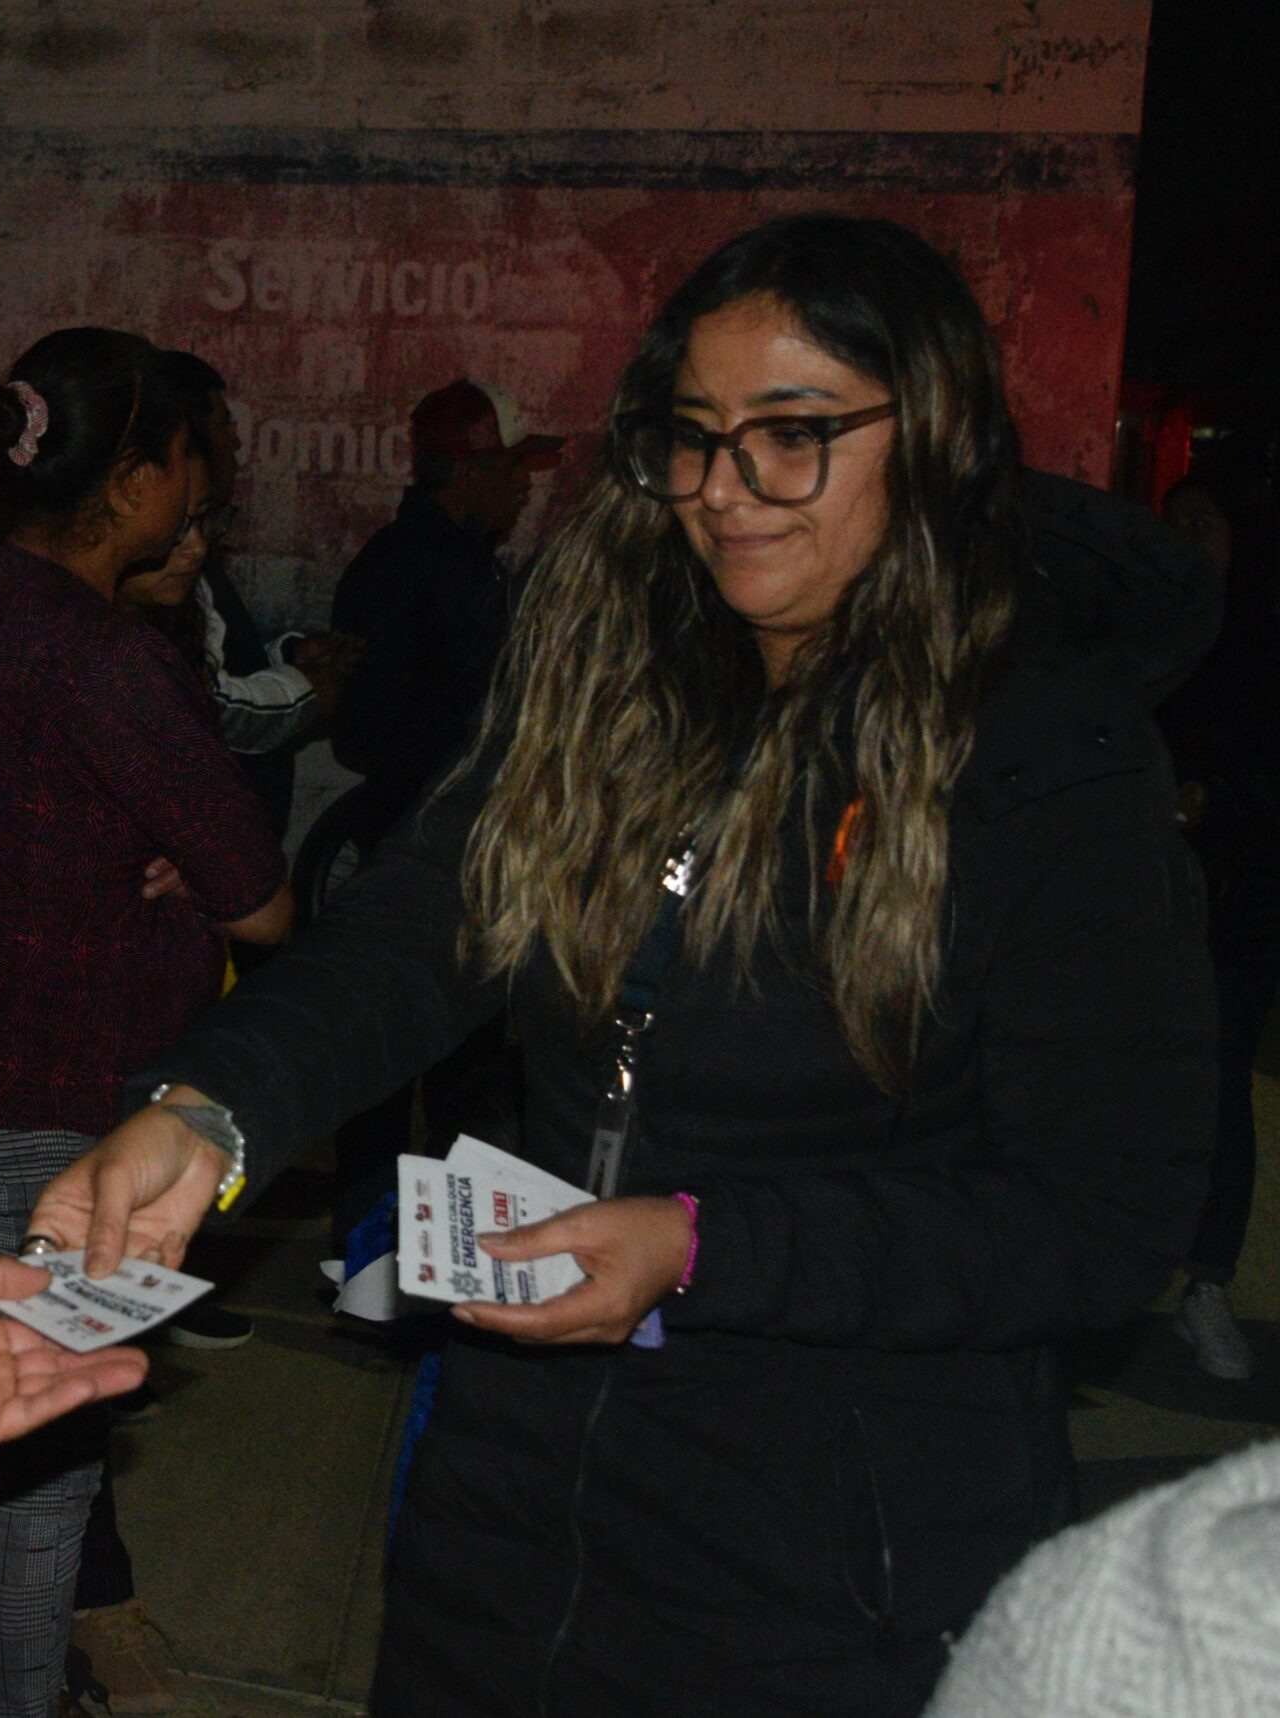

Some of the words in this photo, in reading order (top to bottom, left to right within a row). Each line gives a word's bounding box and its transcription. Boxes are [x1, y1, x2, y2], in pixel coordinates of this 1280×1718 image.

[206, 237, 489, 319] Servicio
[446, 1173, 458, 1222] CUALQUIER
[493, 1191, 509, 1226] 911
[449, 1224, 461, 1265] REPORTA
[458, 1177, 477, 1269] EMERGENCIA
